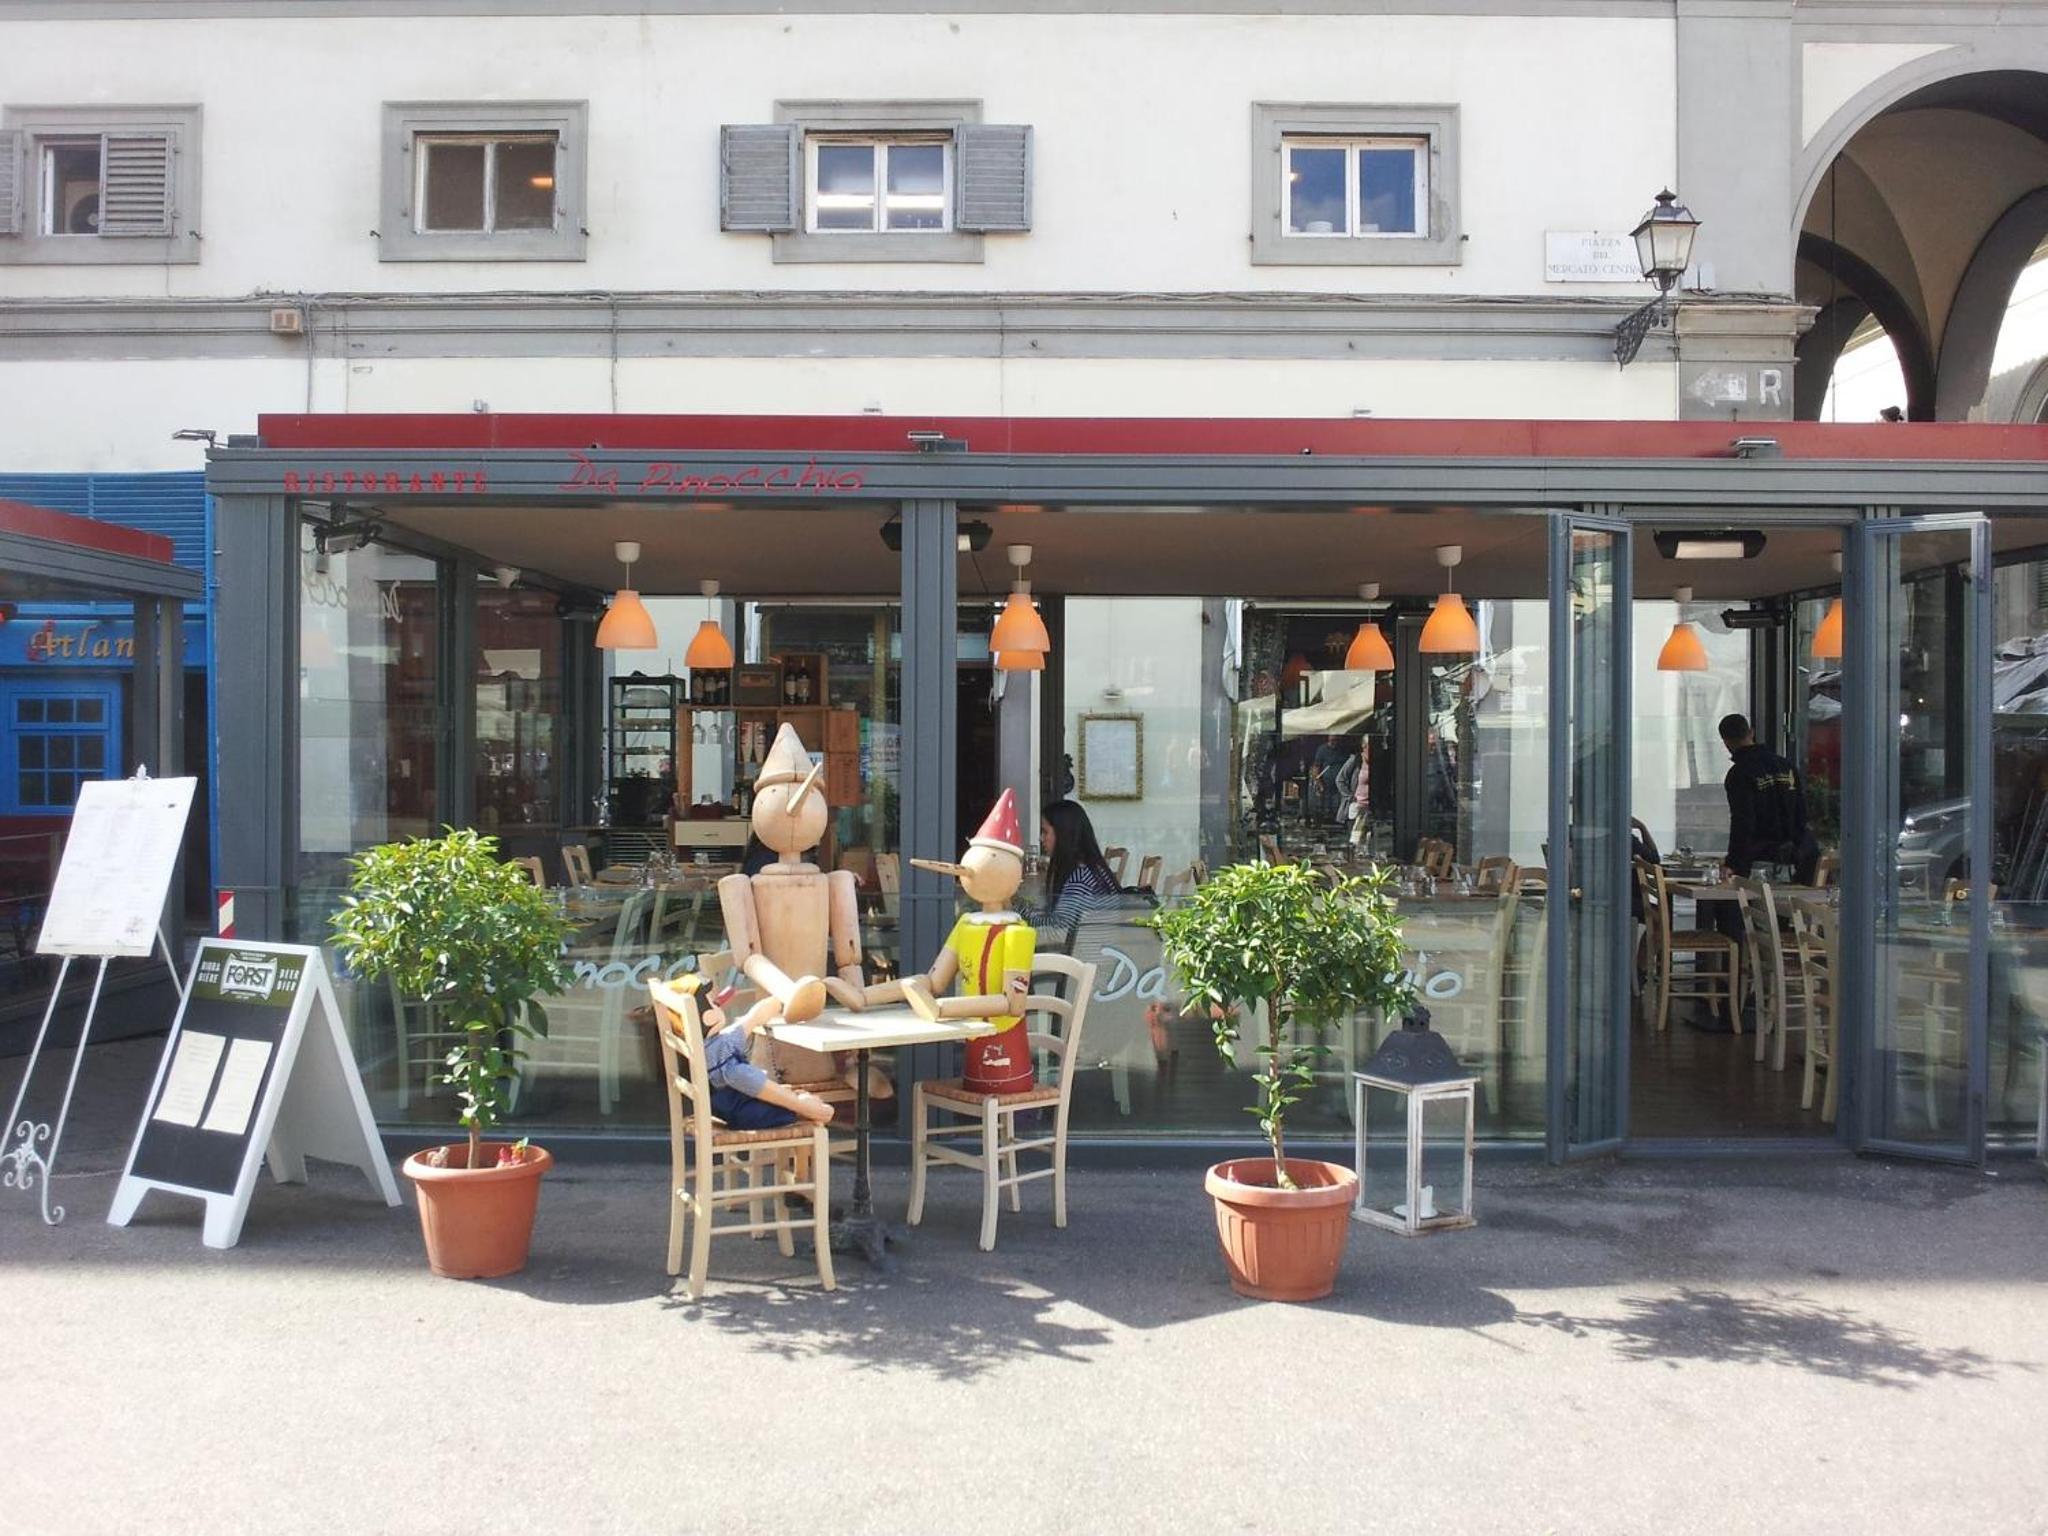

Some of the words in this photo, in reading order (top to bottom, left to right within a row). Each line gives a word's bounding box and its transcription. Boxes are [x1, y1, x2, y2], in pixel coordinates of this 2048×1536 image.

[1580, 239, 1622, 248] PIAZZA
[1548, 263, 1599, 274] MERCATO
[284, 471, 487, 494] RISTORANTE
[559, 452, 620, 494] Da
[640, 456, 866, 495] Pinocchio
[226, 965, 272, 986] FORST
[1093, 946, 1167, 1001] Da
